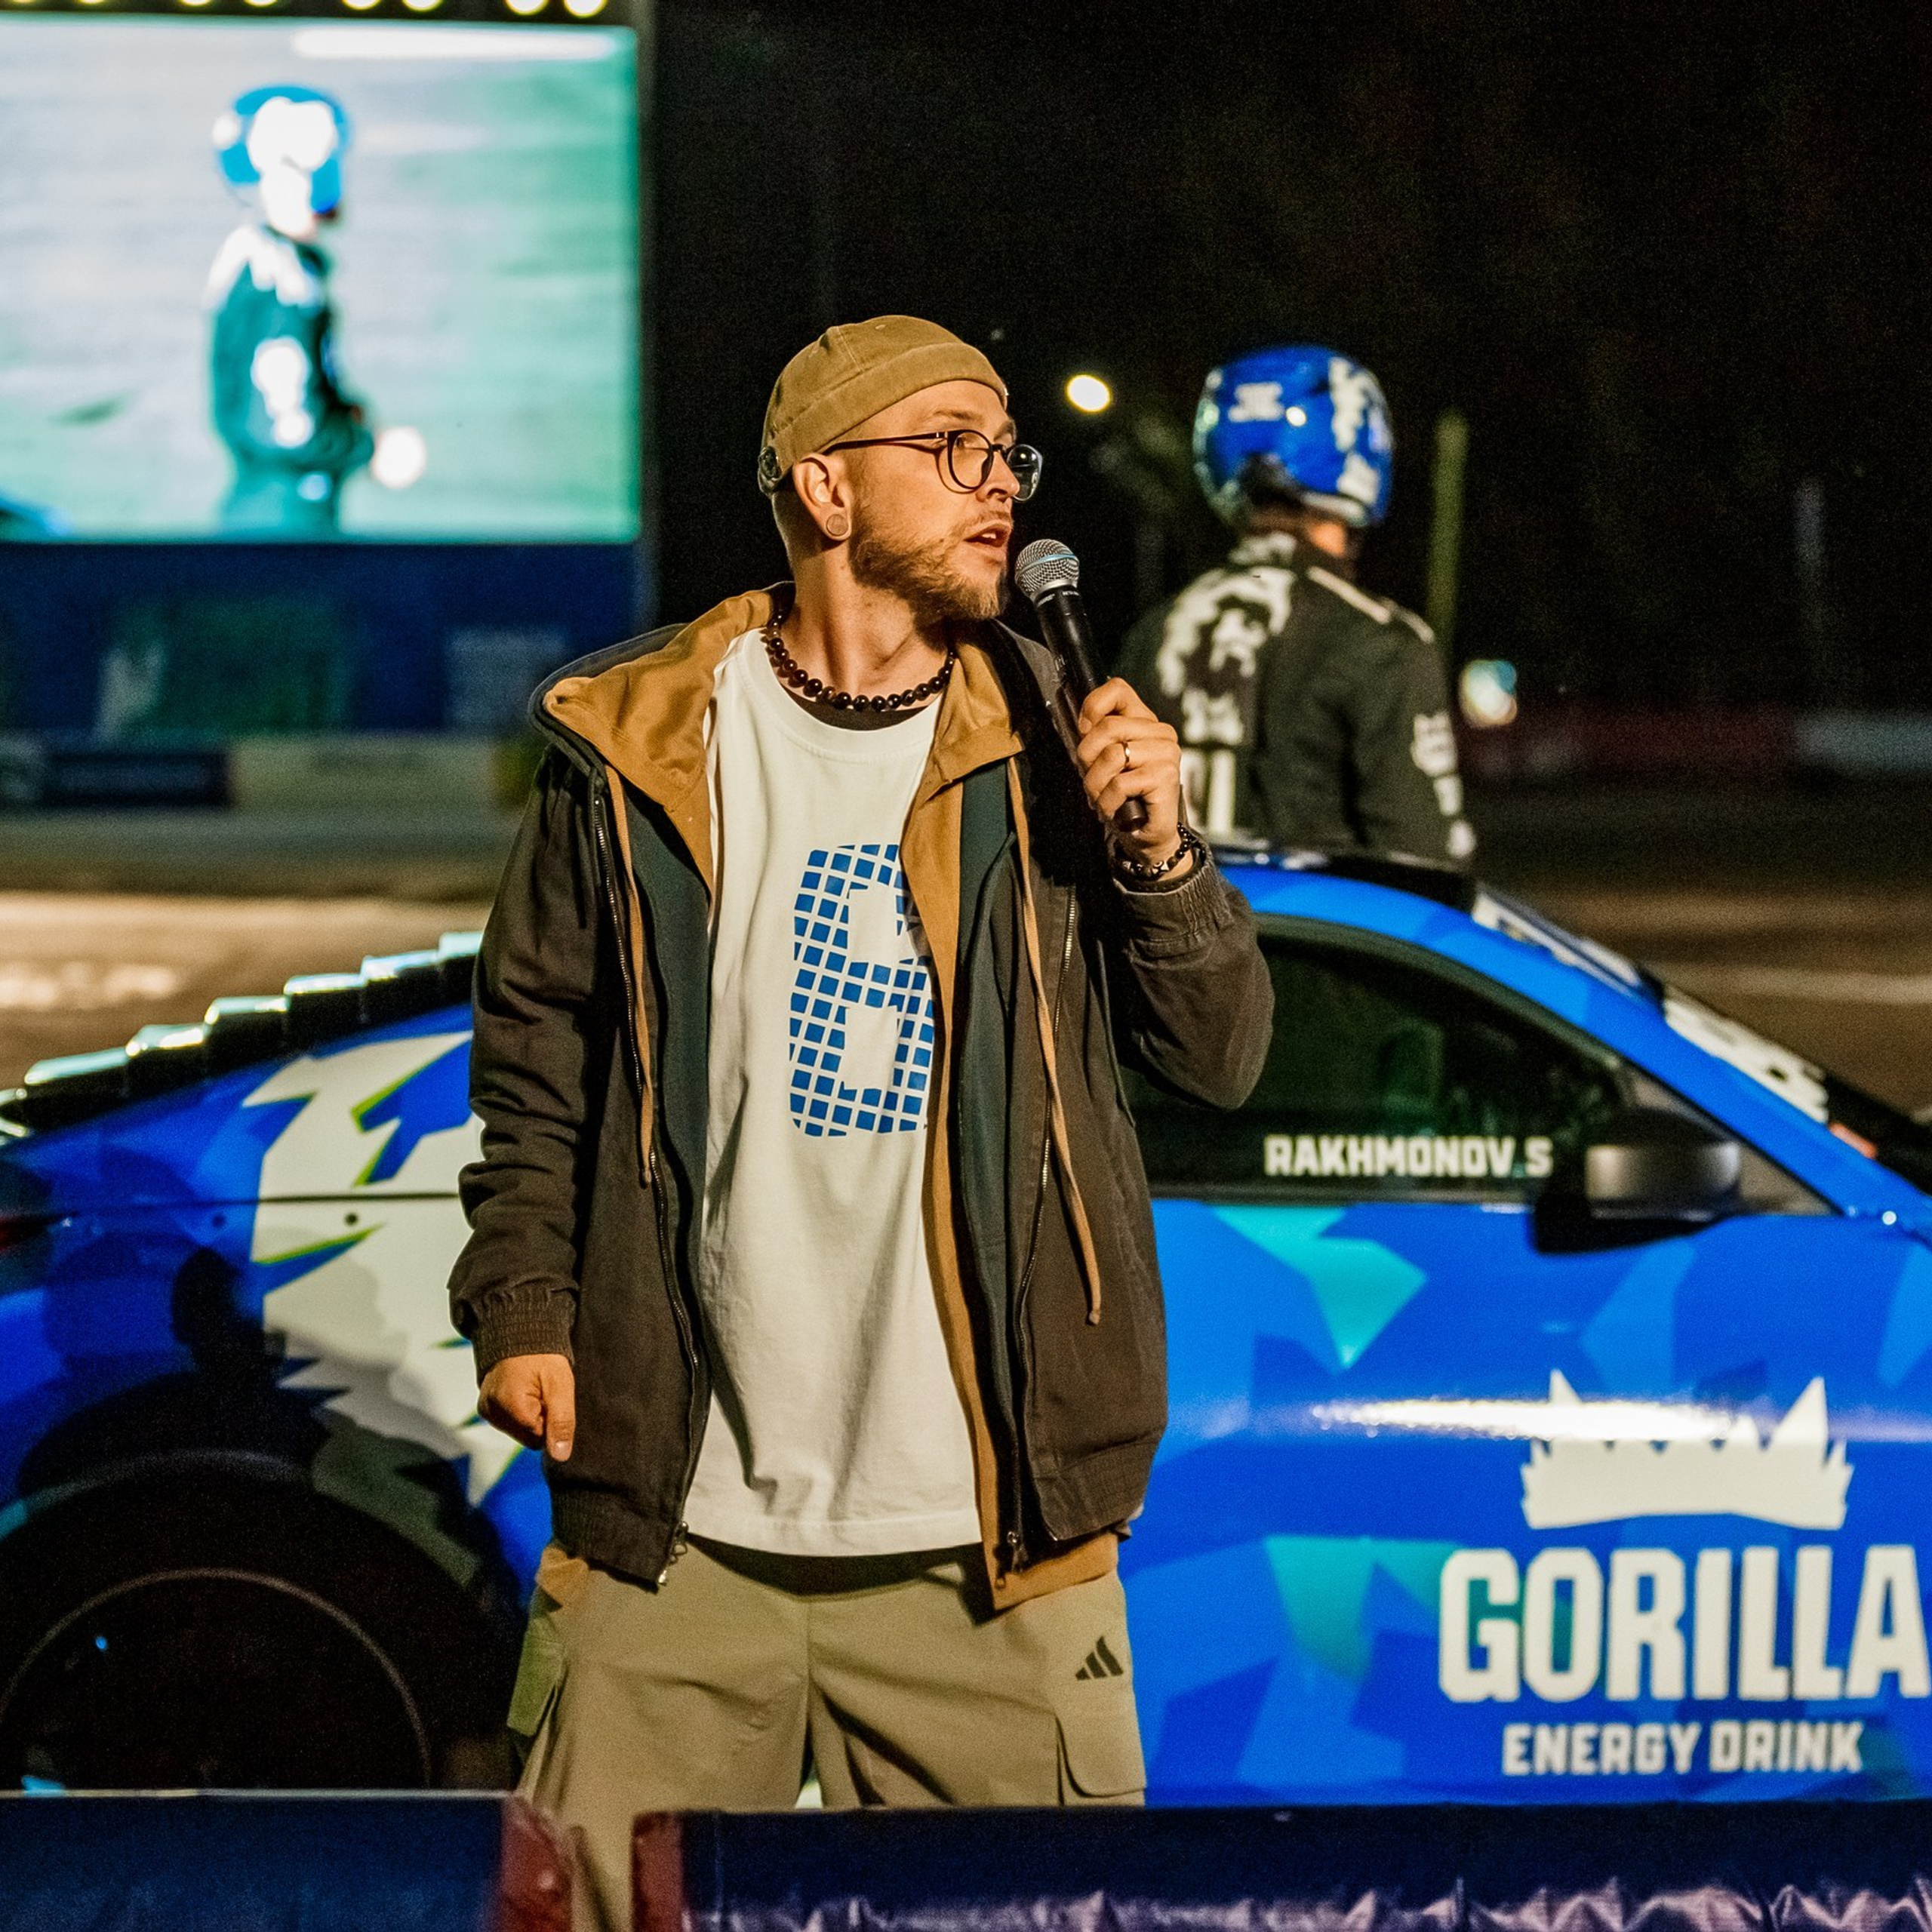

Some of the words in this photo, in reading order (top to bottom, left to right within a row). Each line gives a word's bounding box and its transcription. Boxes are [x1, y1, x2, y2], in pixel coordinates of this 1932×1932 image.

[1263, 1134, 1515, 1177] RAKHMONOV
[1524, 1135, 1553, 1177] S
[1438, 1544, 1932, 1703] GORILLA
[1502, 1722, 1701, 1776] ENERGY
[1709, 1719, 1863, 1774] DRINK
